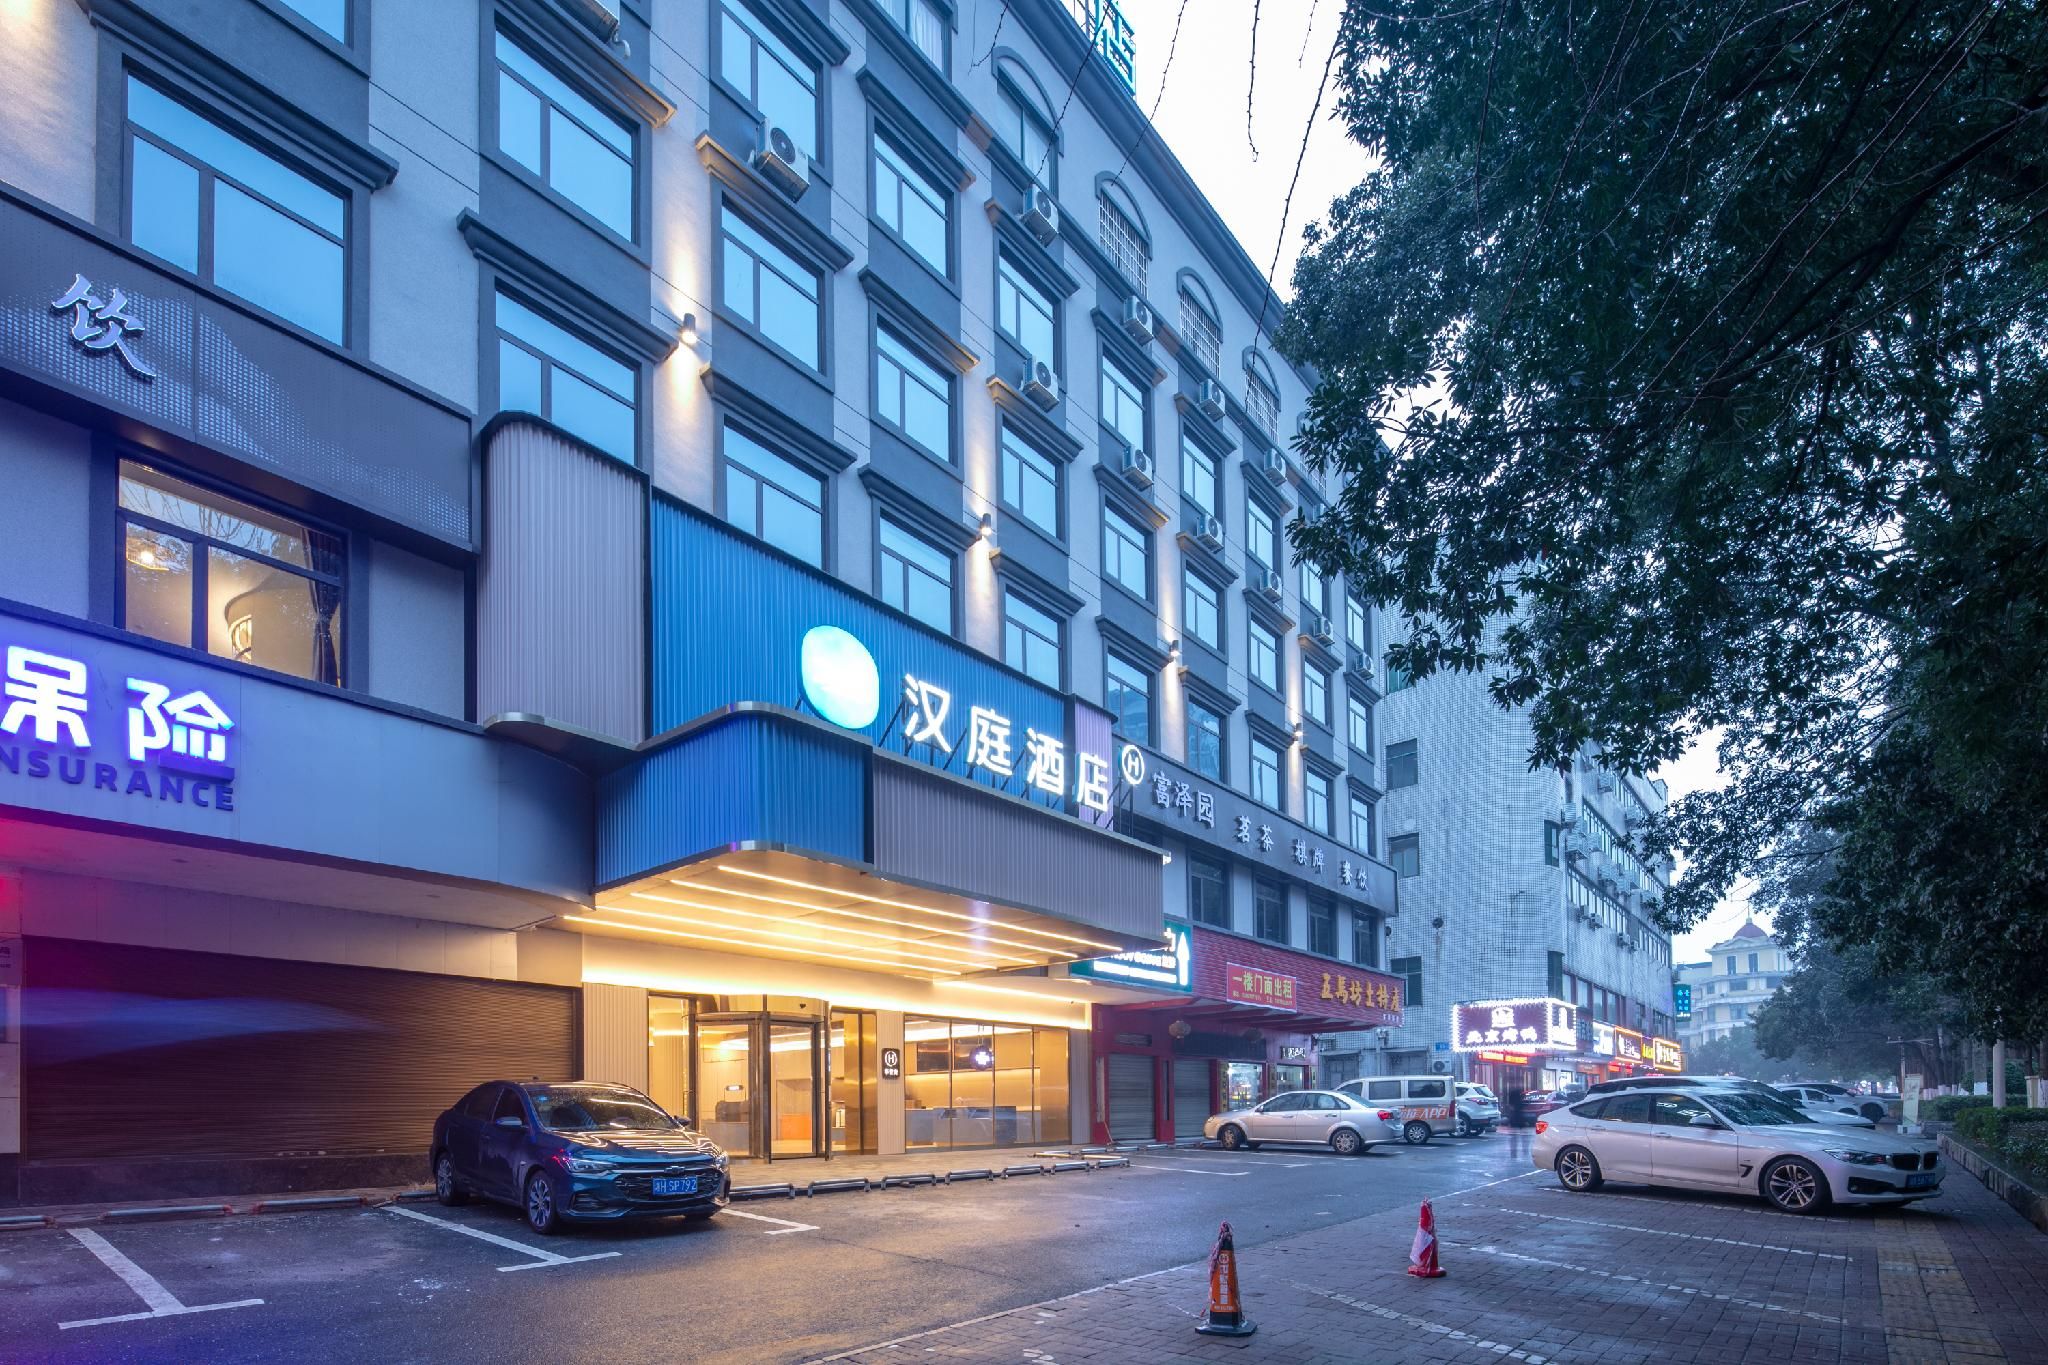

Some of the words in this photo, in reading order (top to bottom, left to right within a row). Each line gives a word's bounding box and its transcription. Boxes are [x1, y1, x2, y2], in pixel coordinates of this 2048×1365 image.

[51, 273, 156, 378] 饮
[904, 673, 1109, 813] 汉庭酒店
[1152, 770, 1215, 828] 富泽园
[1237, 815, 1275, 852] 茗茶
[1294, 839, 1325, 873] 棋牌
[1232, 970, 1293, 998] 一楼门面出租
